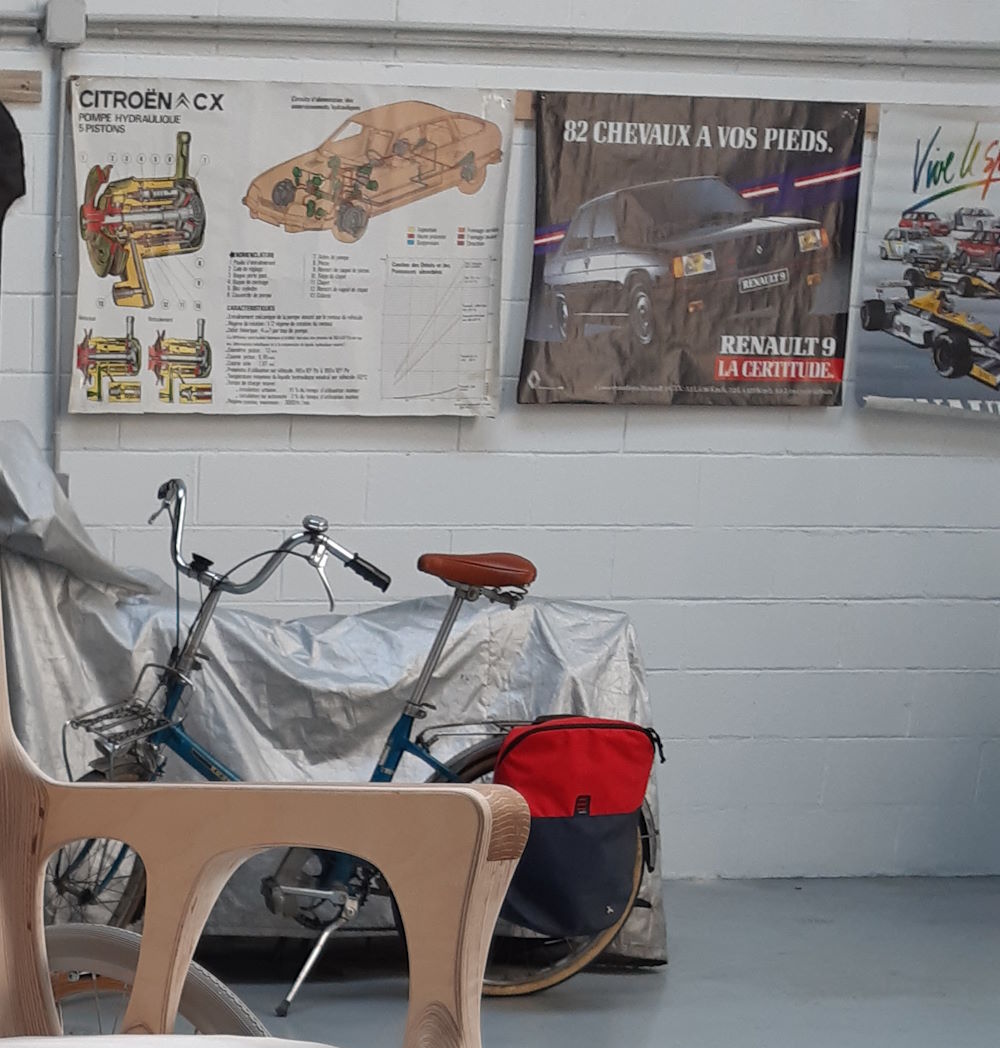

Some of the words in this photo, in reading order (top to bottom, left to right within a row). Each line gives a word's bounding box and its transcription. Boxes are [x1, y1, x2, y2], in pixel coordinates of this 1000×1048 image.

[79, 88, 173, 110] CITROËN
[193, 93, 224, 111] CX
[78, 124, 84, 132] 5
[85, 124, 126, 133] PISTONS
[79, 112, 112, 122] POMPE
[115, 114, 182, 124] HYDRAULIQUE
[563, 120, 589, 143] 82
[593, 121, 692, 147] CHEVAUX
[696, 127, 713, 148] A
[717, 125, 758, 150] VOS
[763, 127, 834, 153] PIEDS.
[720, 335, 820, 356] RENAULT
[821, 336, 837, 357] 9
[718, 359, 739, 378] LA
[741, 360, 835, 379] CERTITUDE.
